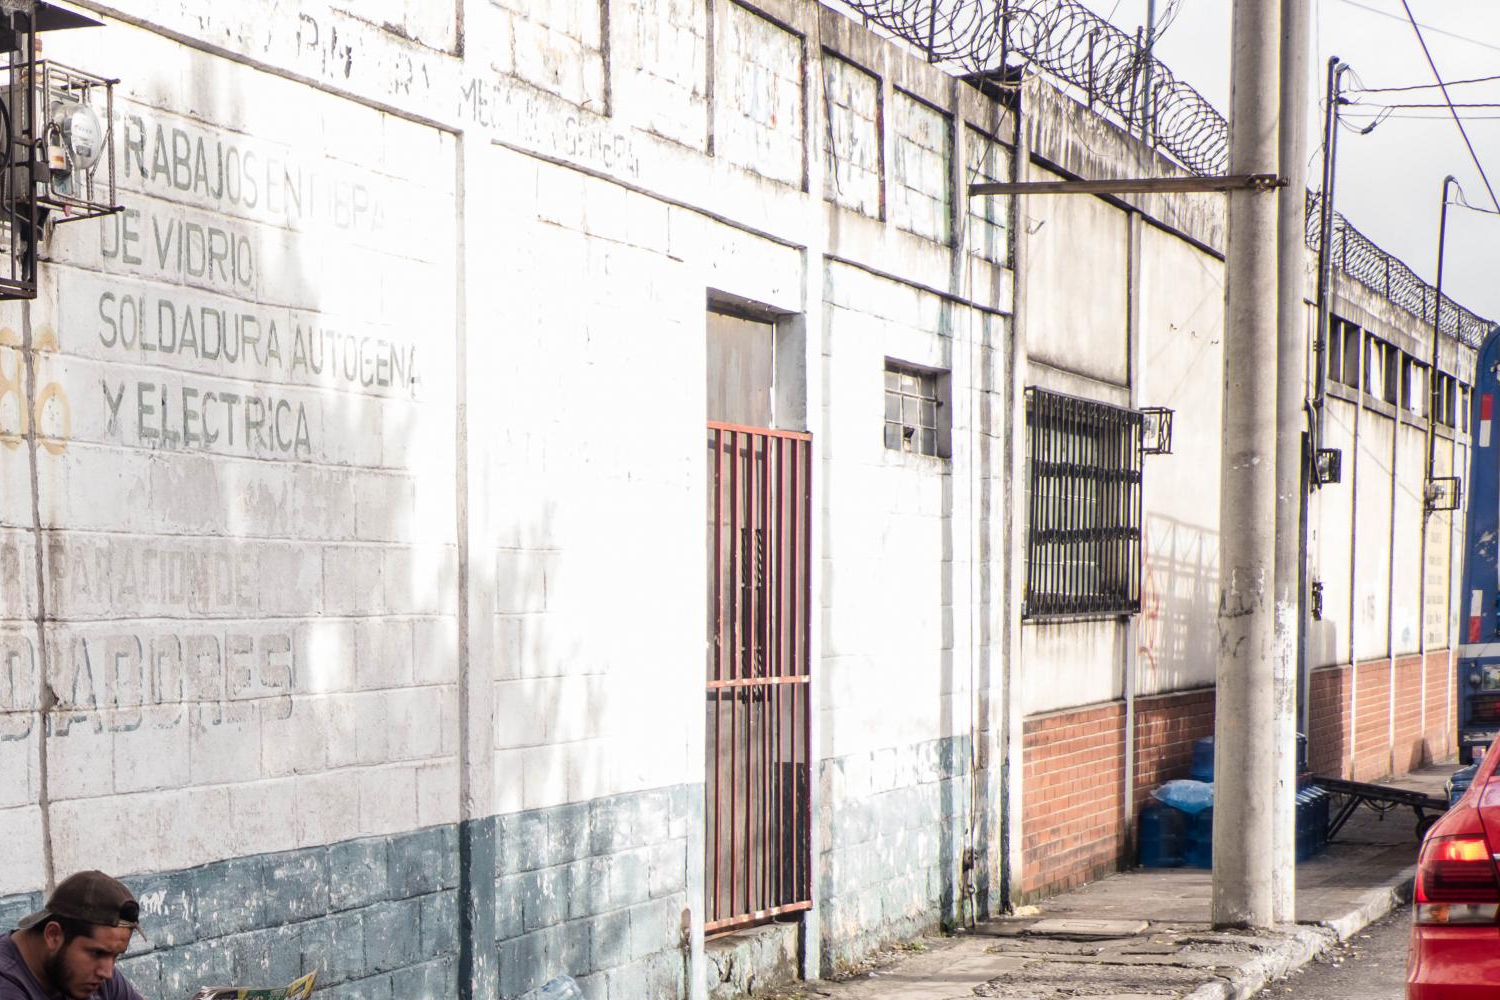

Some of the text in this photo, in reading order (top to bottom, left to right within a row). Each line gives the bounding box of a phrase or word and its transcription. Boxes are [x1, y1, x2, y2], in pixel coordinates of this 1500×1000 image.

[151, 214, 253, 288] VIDRIO
[98, 291, 282, 369] SOLDADURA
[100, 378, 312, 457] Y ELECTRICA
